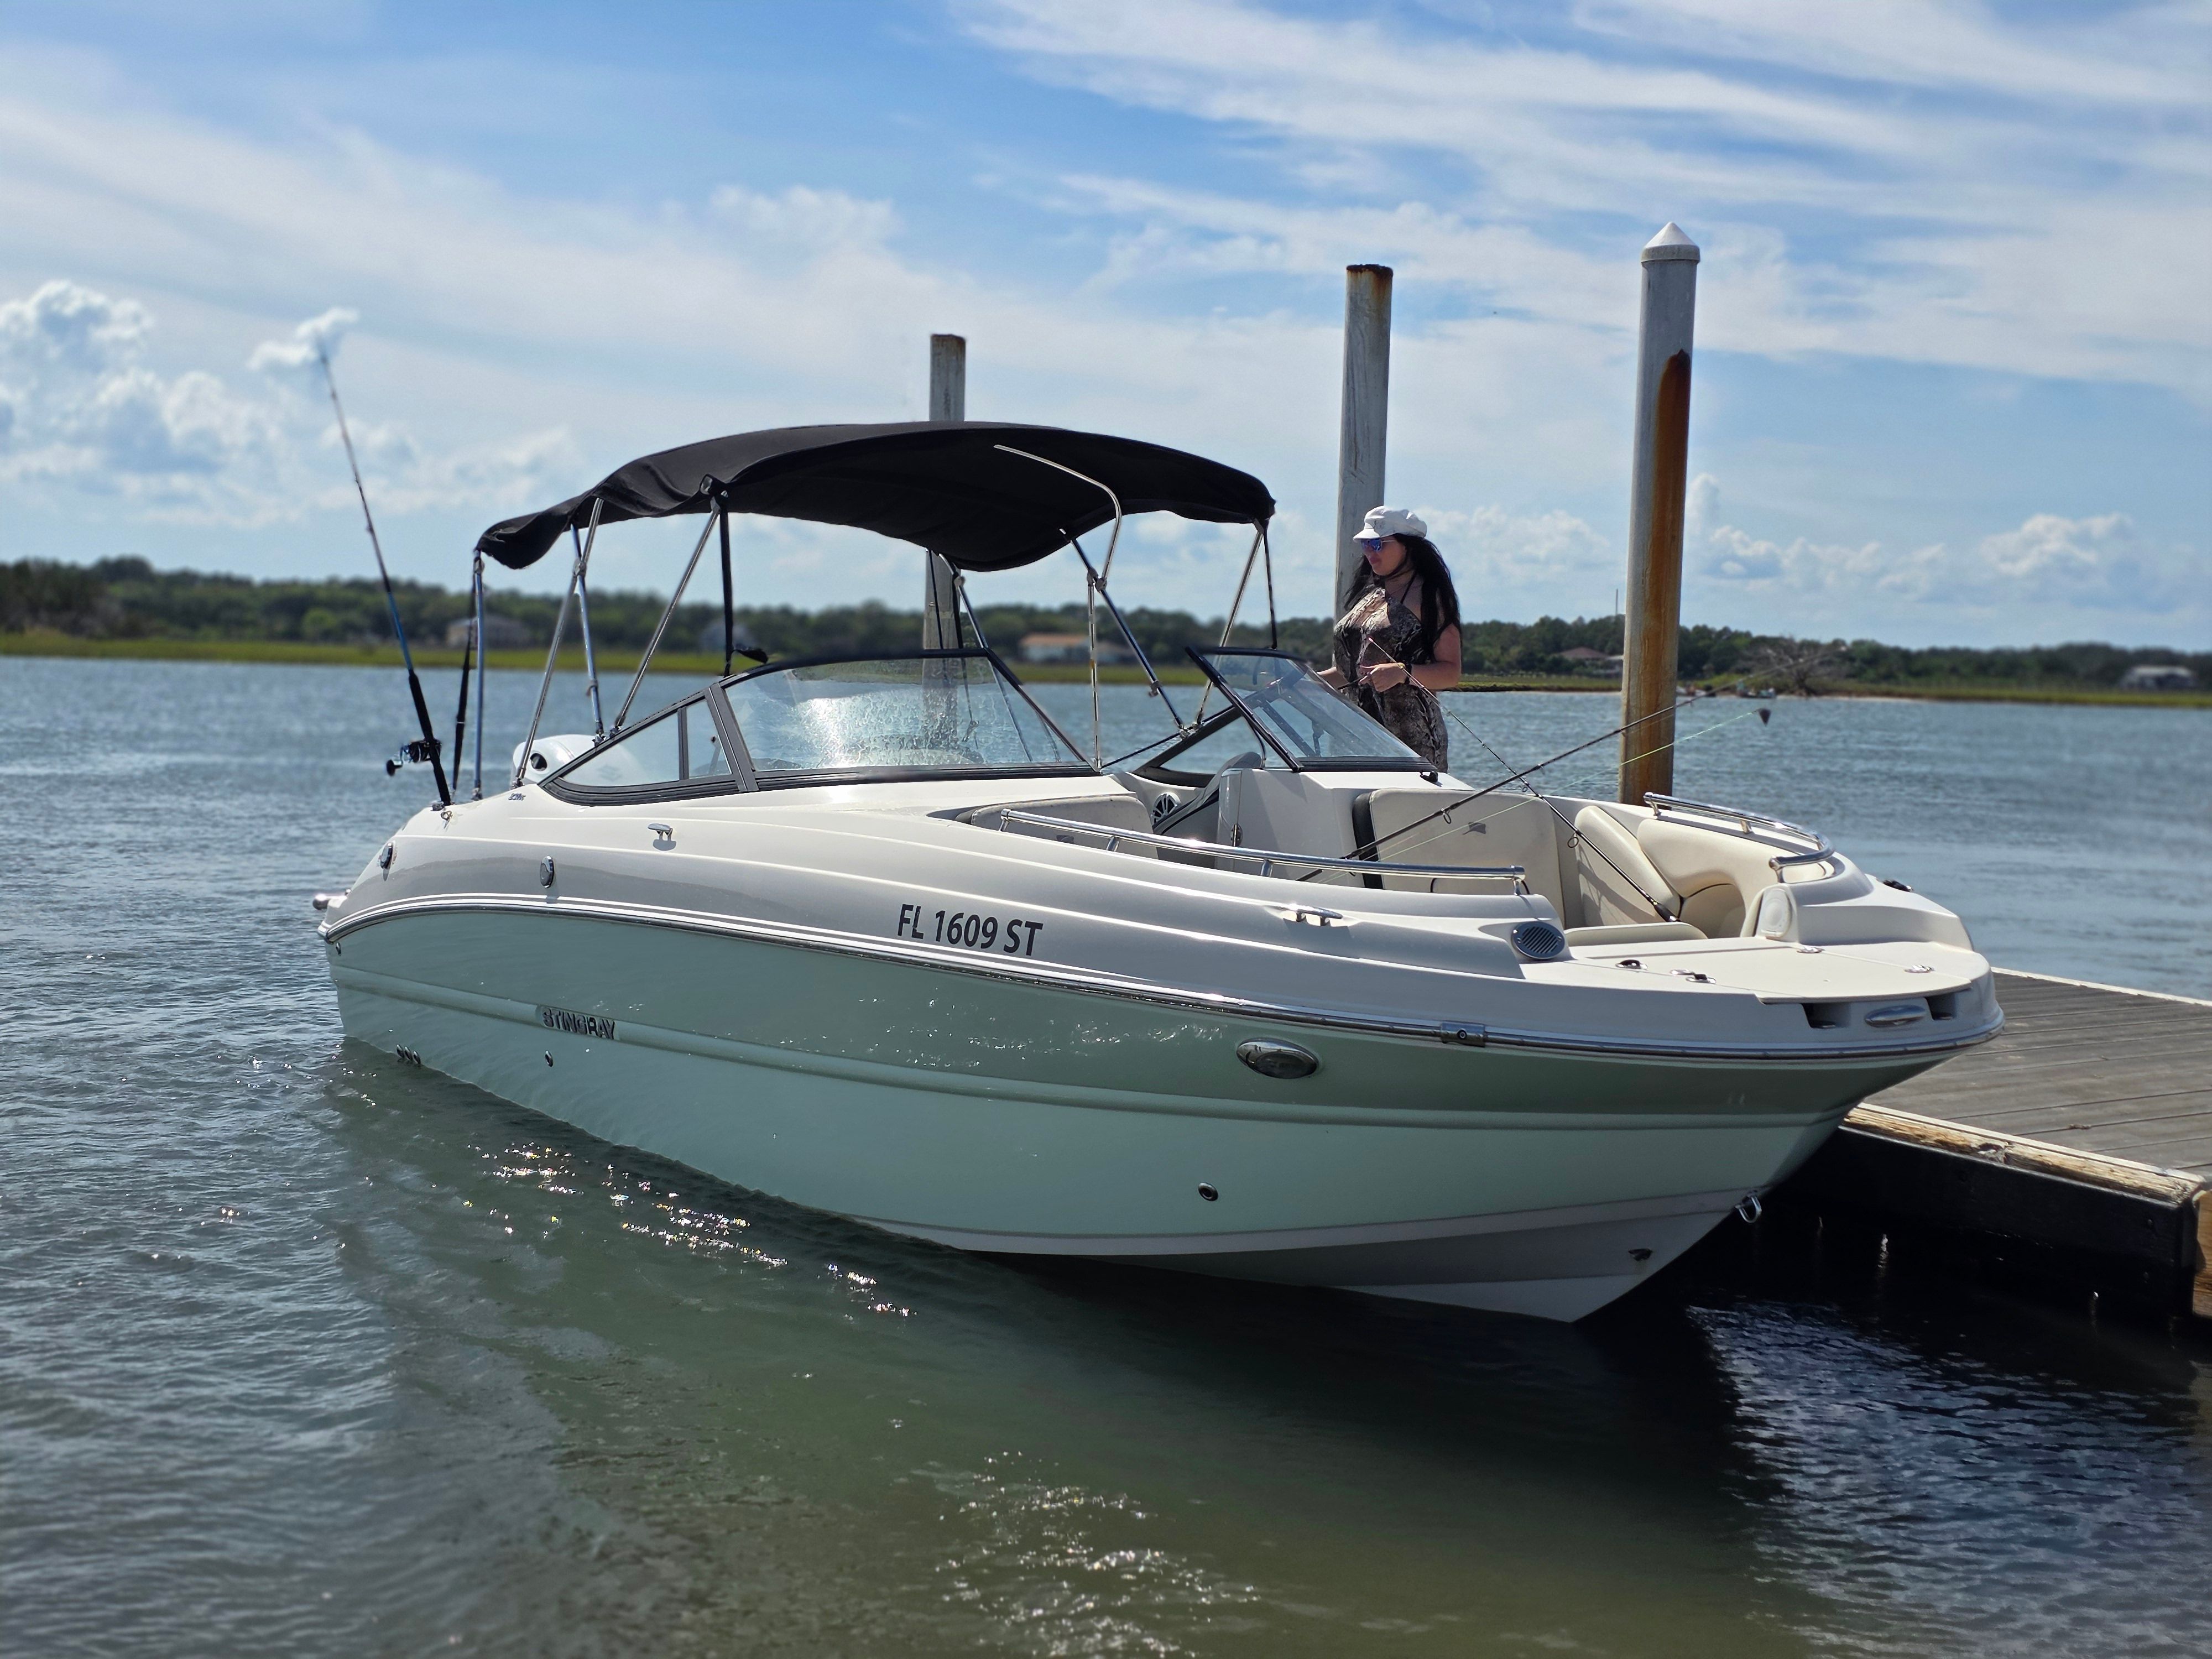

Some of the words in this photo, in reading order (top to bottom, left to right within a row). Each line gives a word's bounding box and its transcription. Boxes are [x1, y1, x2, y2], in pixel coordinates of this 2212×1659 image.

[897, 904, 924, 940] FL
[935, 910, 998, 949] 1609
[1003, 919, 1044, 956] ST
[542, 1008, 615, 1040] STINGRAY
